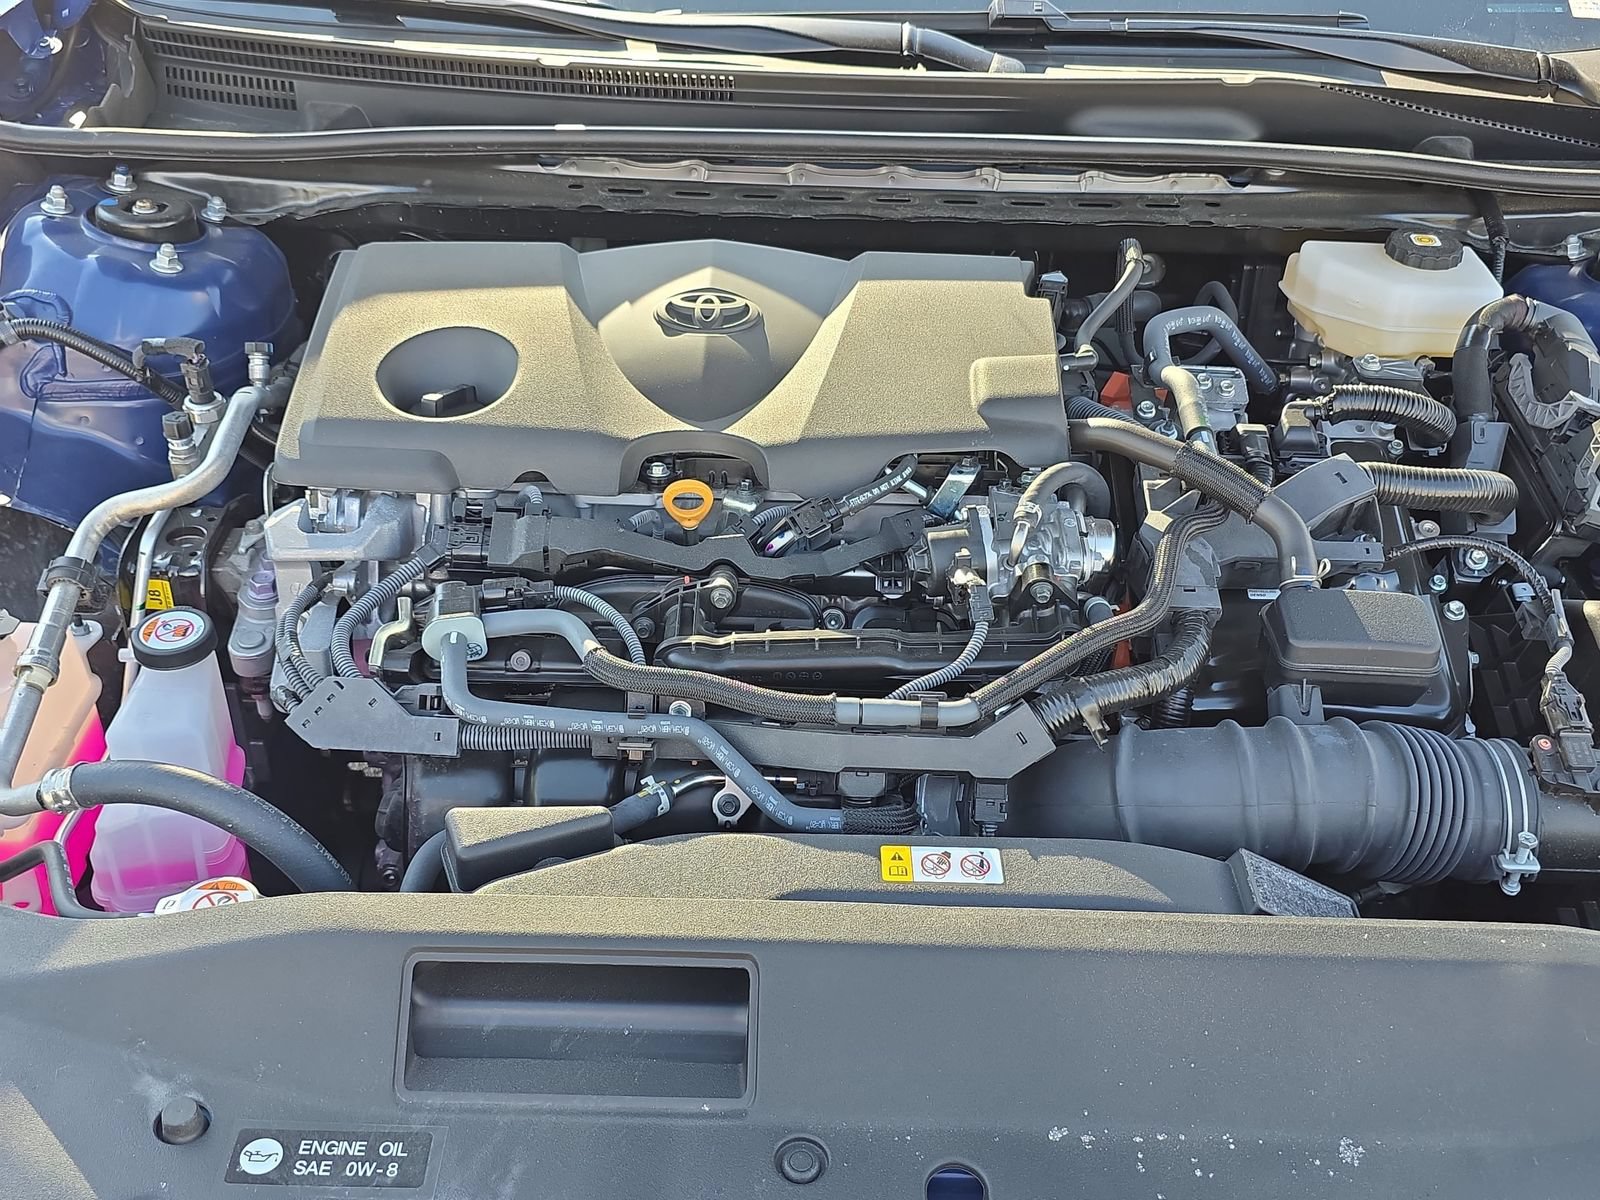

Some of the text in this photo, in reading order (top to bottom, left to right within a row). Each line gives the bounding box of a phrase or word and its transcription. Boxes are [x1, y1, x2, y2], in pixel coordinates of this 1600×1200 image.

[149, 590, 162, 605] J8
[299, 1140, 408, 1157] ENGINE OIL
[293, 1160, 398, 1177] SAE 0W-8
